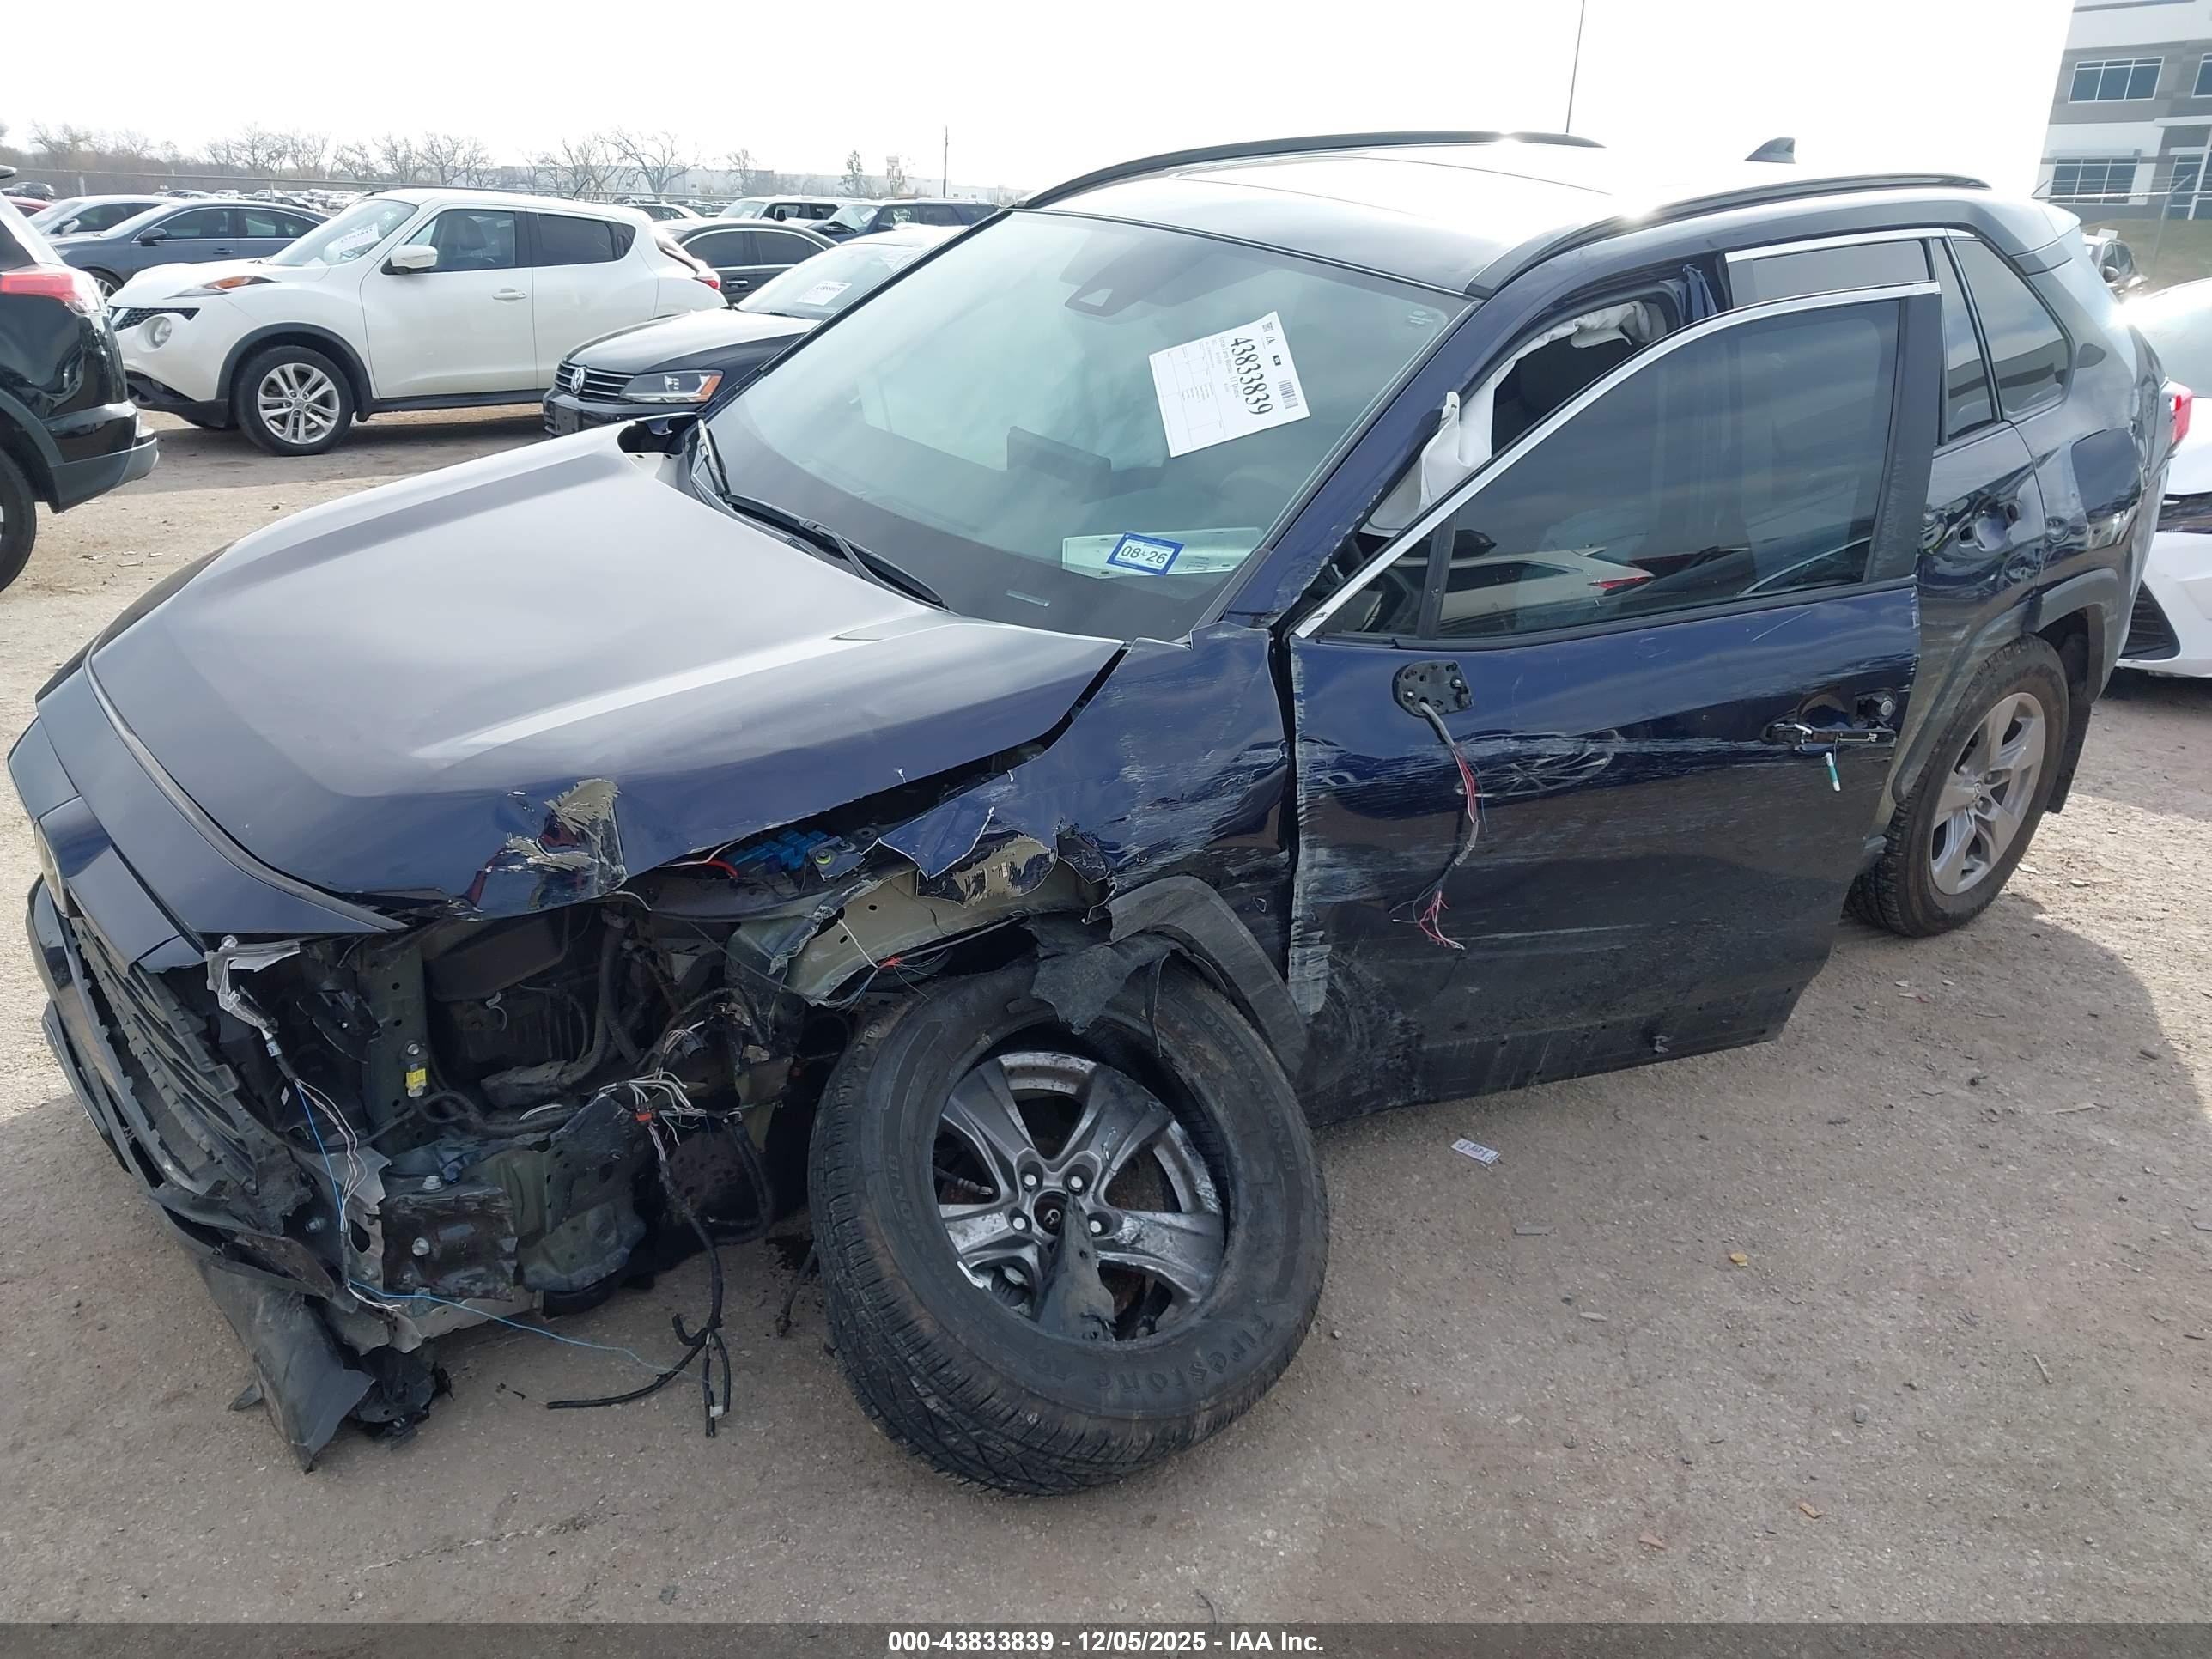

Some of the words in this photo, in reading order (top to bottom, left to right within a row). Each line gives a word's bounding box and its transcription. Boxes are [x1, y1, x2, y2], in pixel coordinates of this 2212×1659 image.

[1231, 337, 1273, 416] 43833839
[1121, 545, 1142, 558] 08
[1146, 550, 1169, 564] 26
[1094, 1312, 1274, 1395] Firestone
